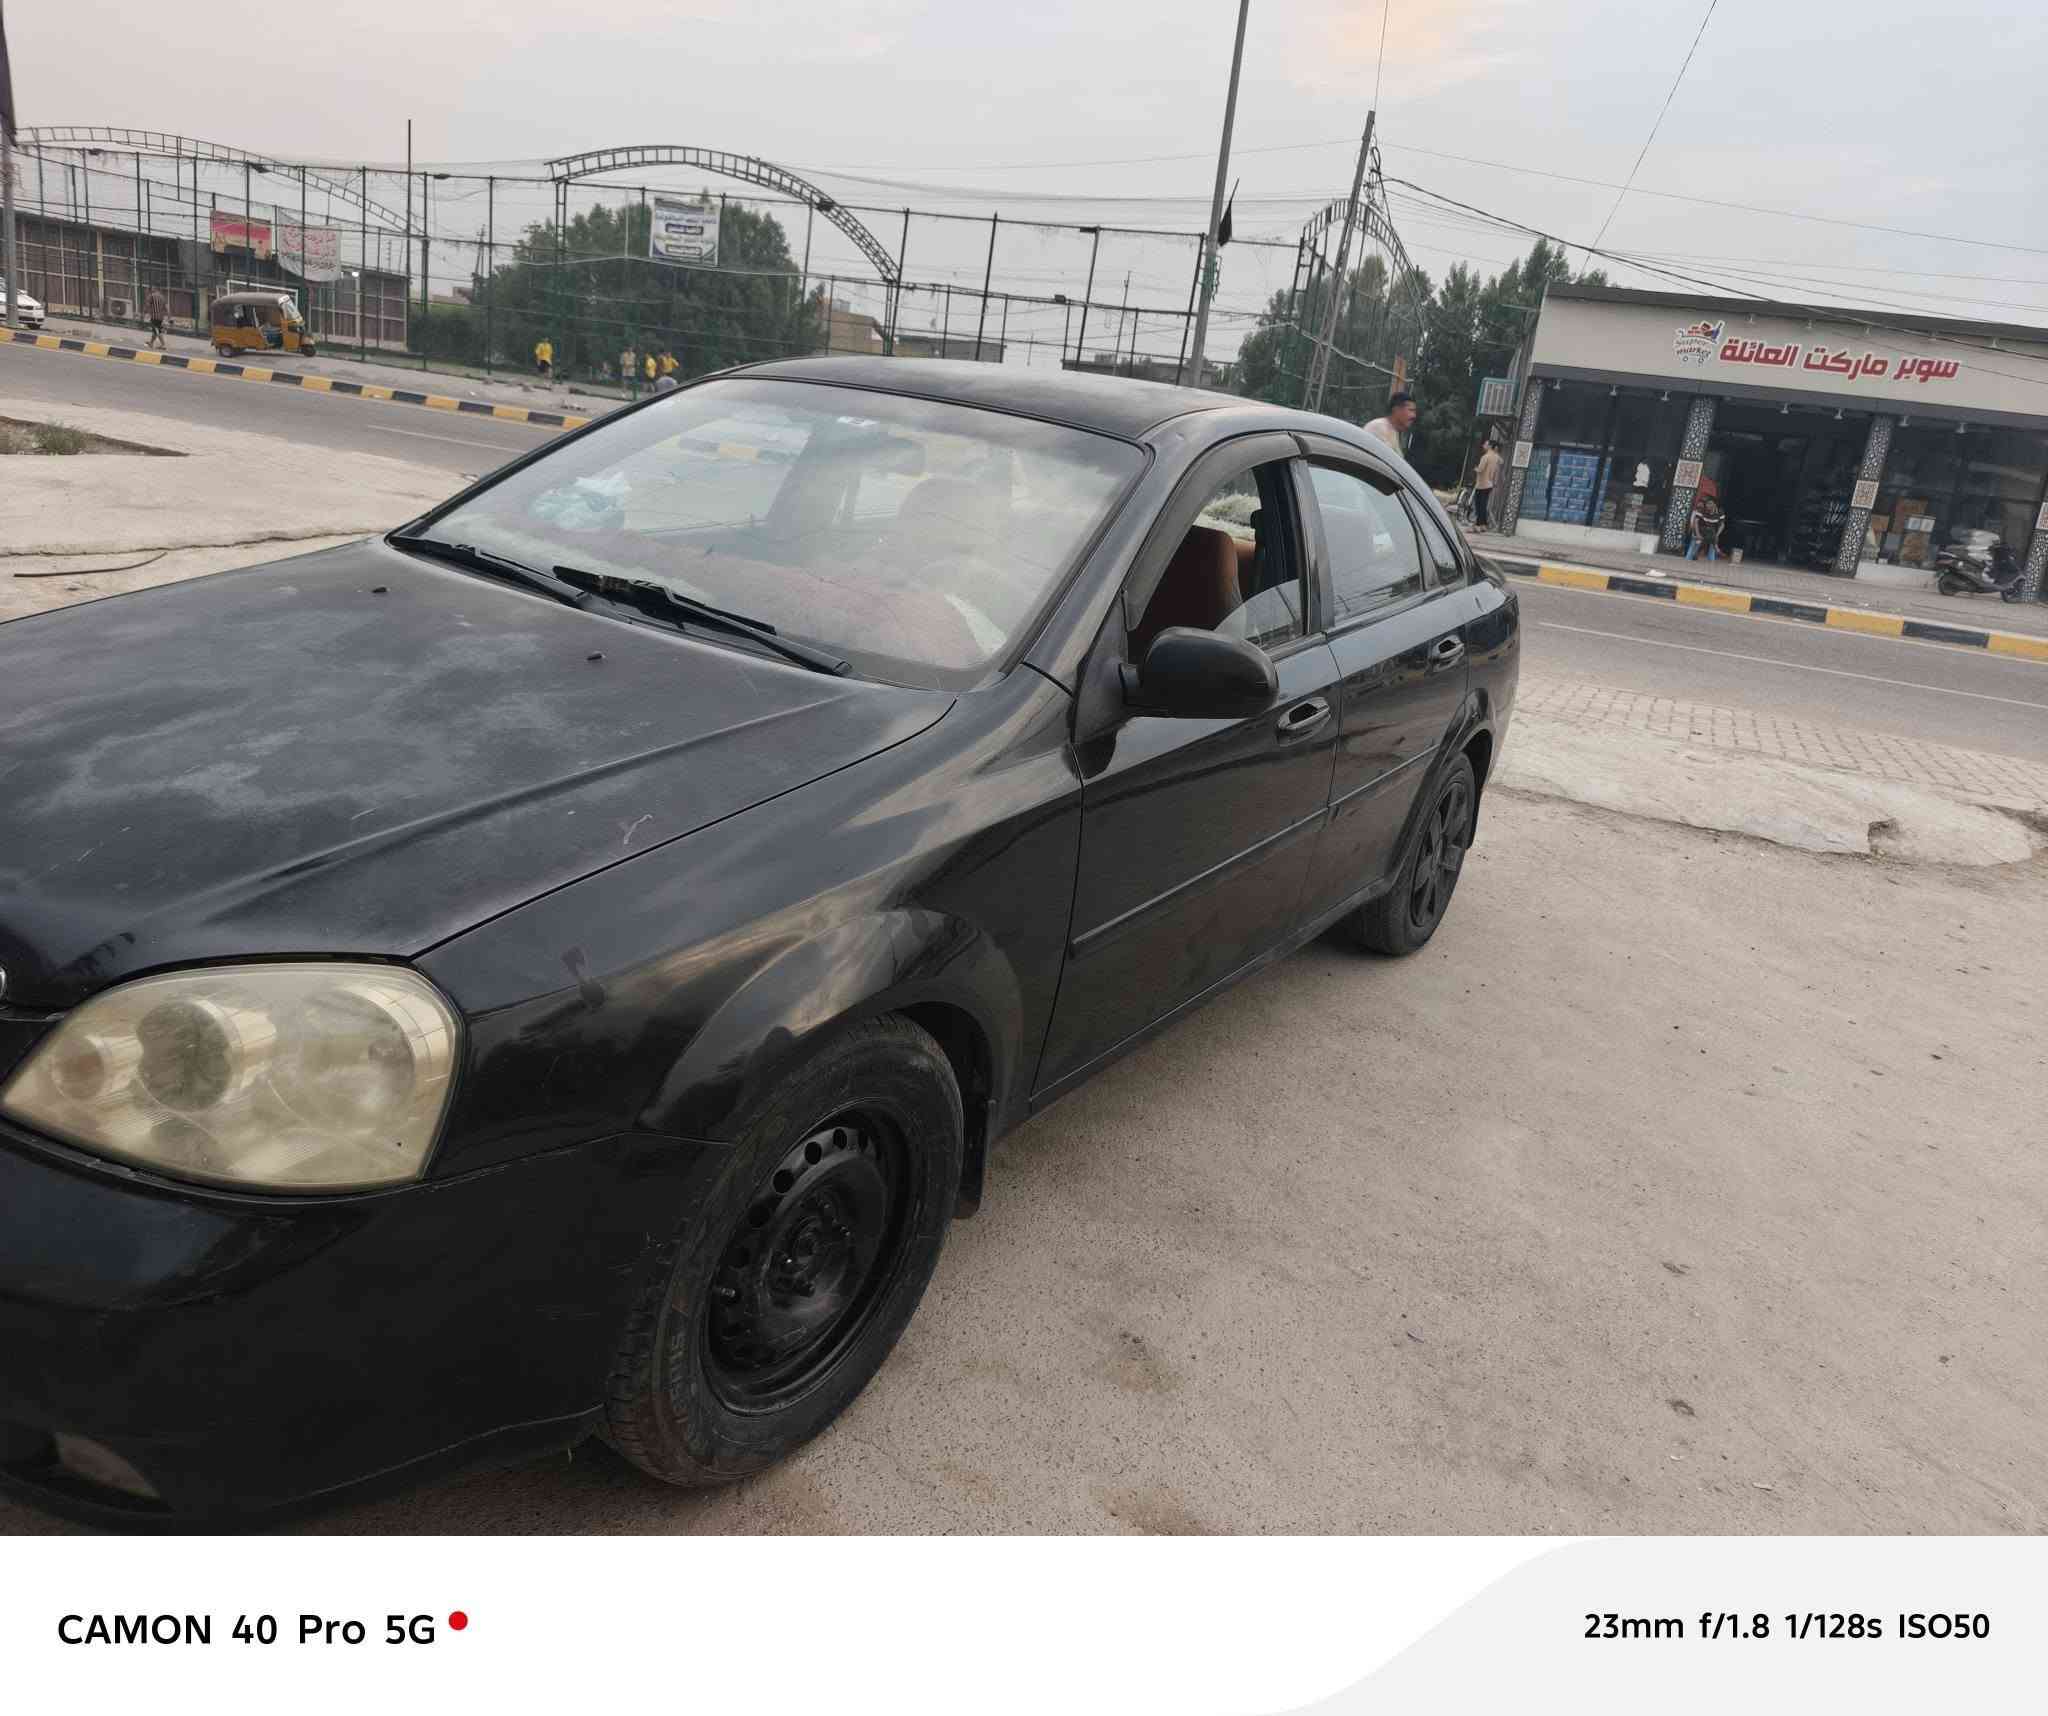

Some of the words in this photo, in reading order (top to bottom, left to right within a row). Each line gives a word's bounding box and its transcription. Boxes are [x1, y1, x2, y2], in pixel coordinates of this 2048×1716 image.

[1720, 338, 1798, 366] العائلة
[1803, 347, 1888, 380] ماركت
[1895, 357, 1959, 382] سوبر
